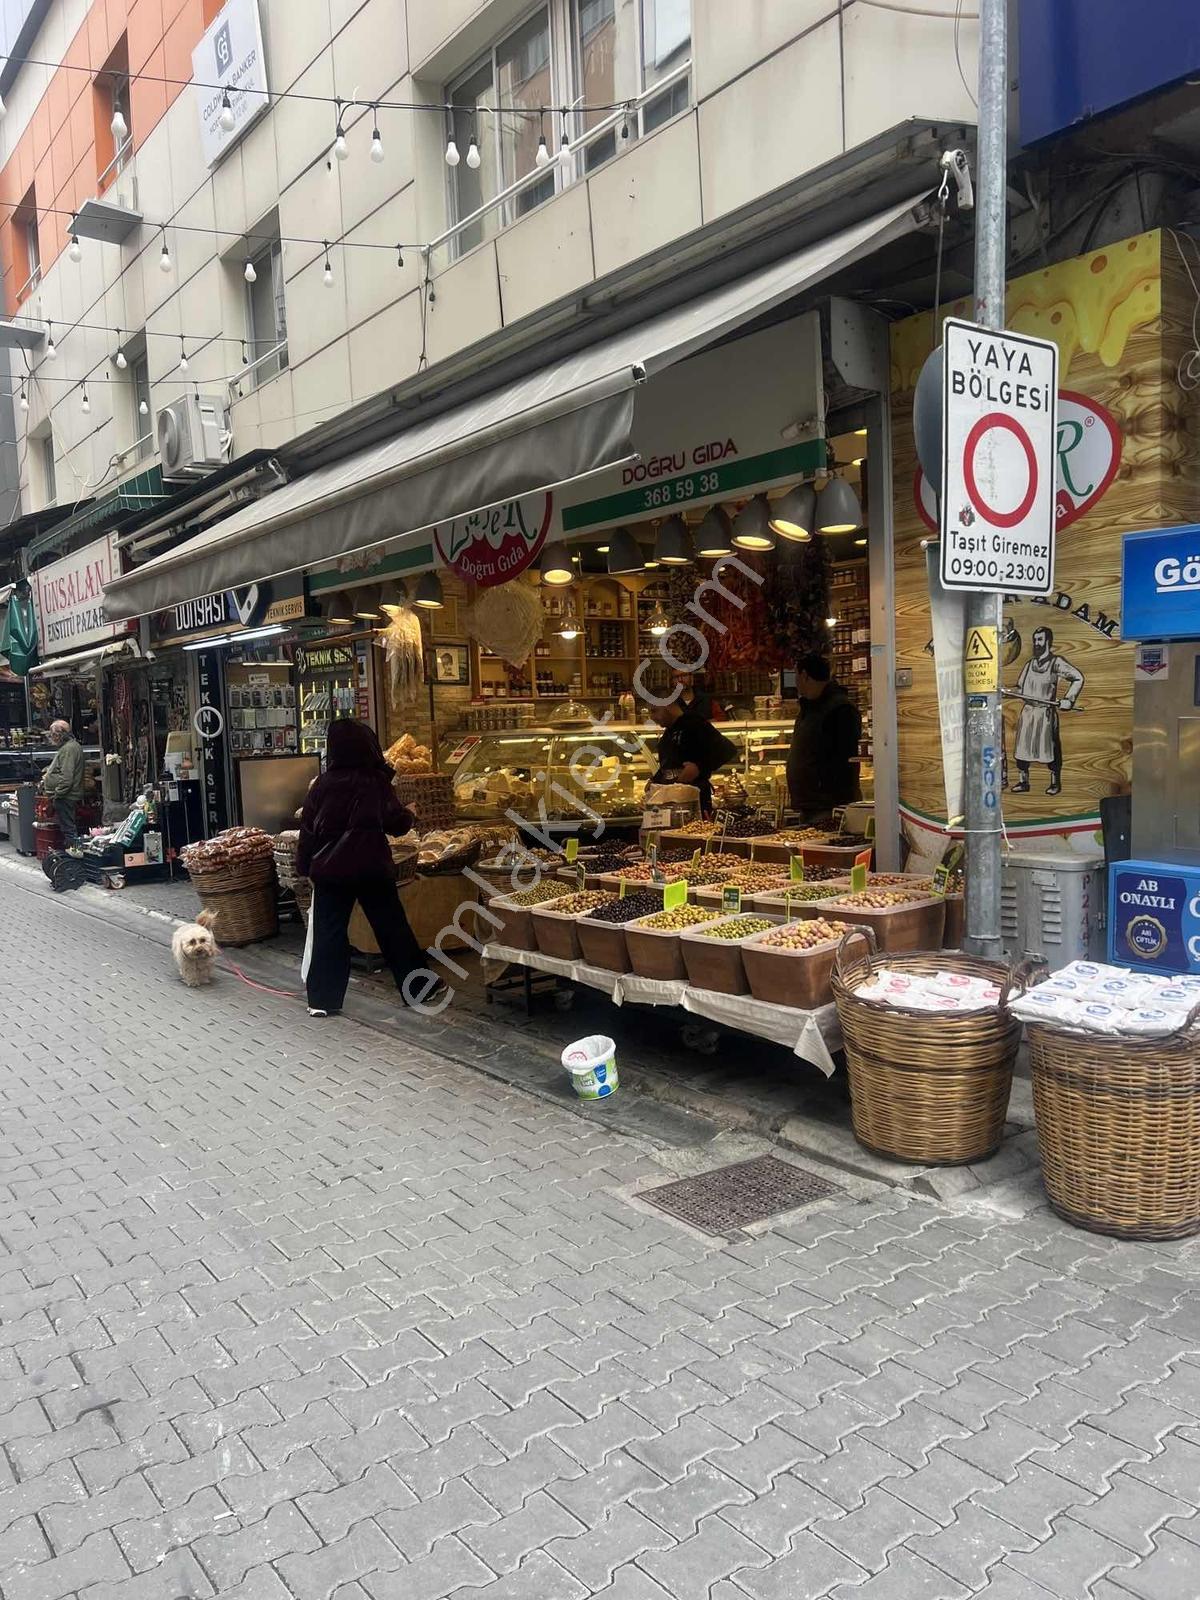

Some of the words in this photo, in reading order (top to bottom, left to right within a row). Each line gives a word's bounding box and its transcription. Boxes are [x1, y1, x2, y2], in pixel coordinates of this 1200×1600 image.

[231, 50, 257, 87] BANKER
[967, 339, 1032, 377] YAYA
[952, 367, 1049, 412] BÖLGESİ
[622, 451, 686, 486] DOĞRU
[692, 438, 738, 465] GIDA
[643, 485, 671, 508] 368
[675, 479, 695, 499] 59
[700, 472, 720, 493] 38
[949, 531, 987, 553] Taşıt
[992, 534, 1048, 558] Giremez
[460, 555, 496, 580] Doğru
[497, 546, 526, 572] Gıda
[950, 557, 1046, 582] 09:00-23:00
[1120, 892, 1176, 910] ONAYLI
[1137, 879, 1158, 892] AB
